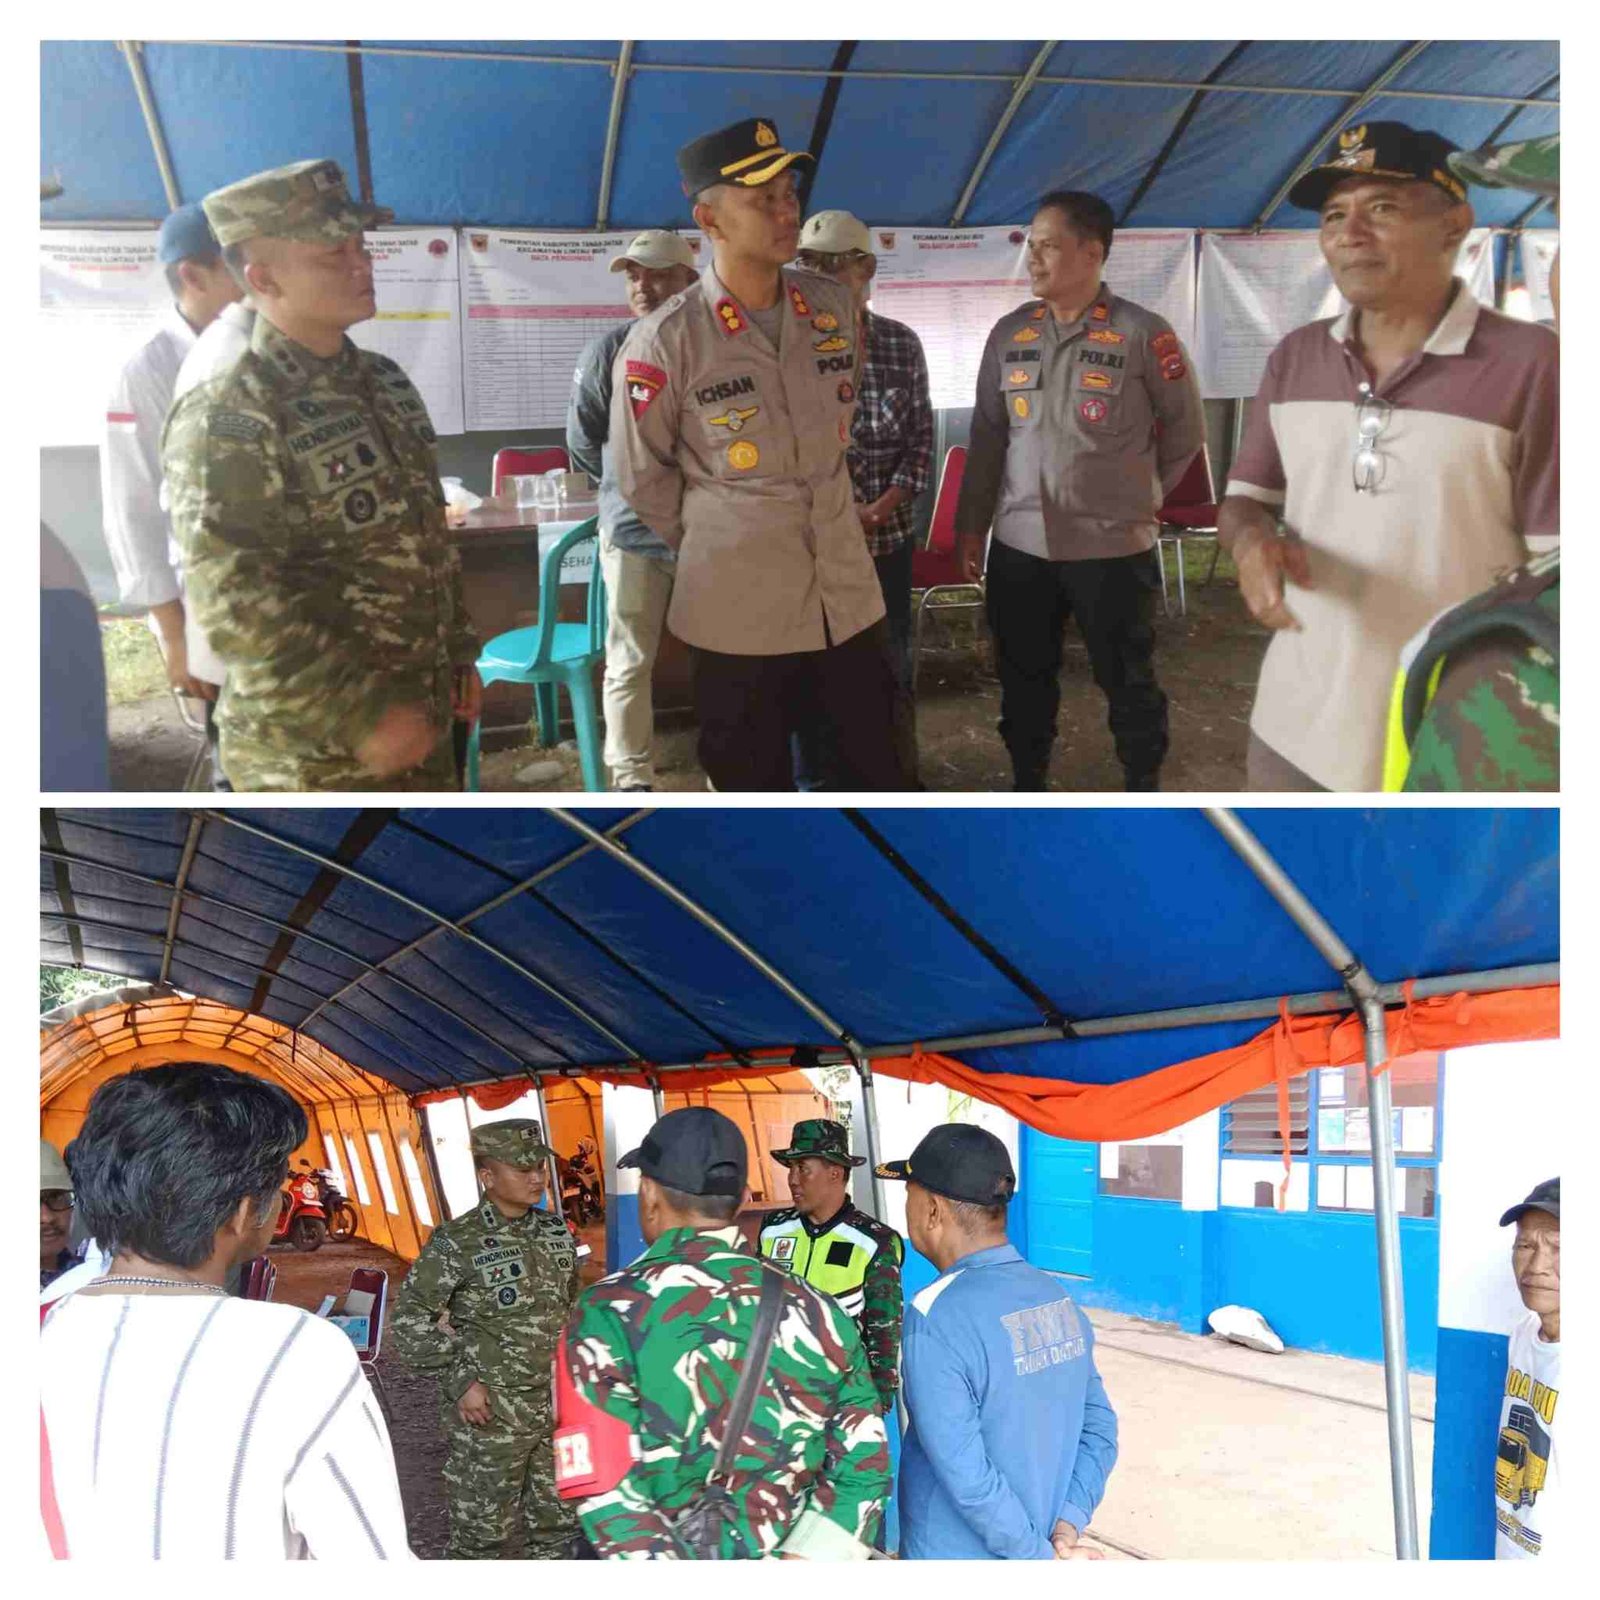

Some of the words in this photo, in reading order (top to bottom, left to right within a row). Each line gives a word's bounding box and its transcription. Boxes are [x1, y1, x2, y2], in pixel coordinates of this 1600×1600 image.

[1079, 350, 1125, 369] POLRI
[697, 376, 755, 406] ICHSAN
[560, 555, 593, 568] SEHA
[1530, 1379, 1559, 1425] IBU
